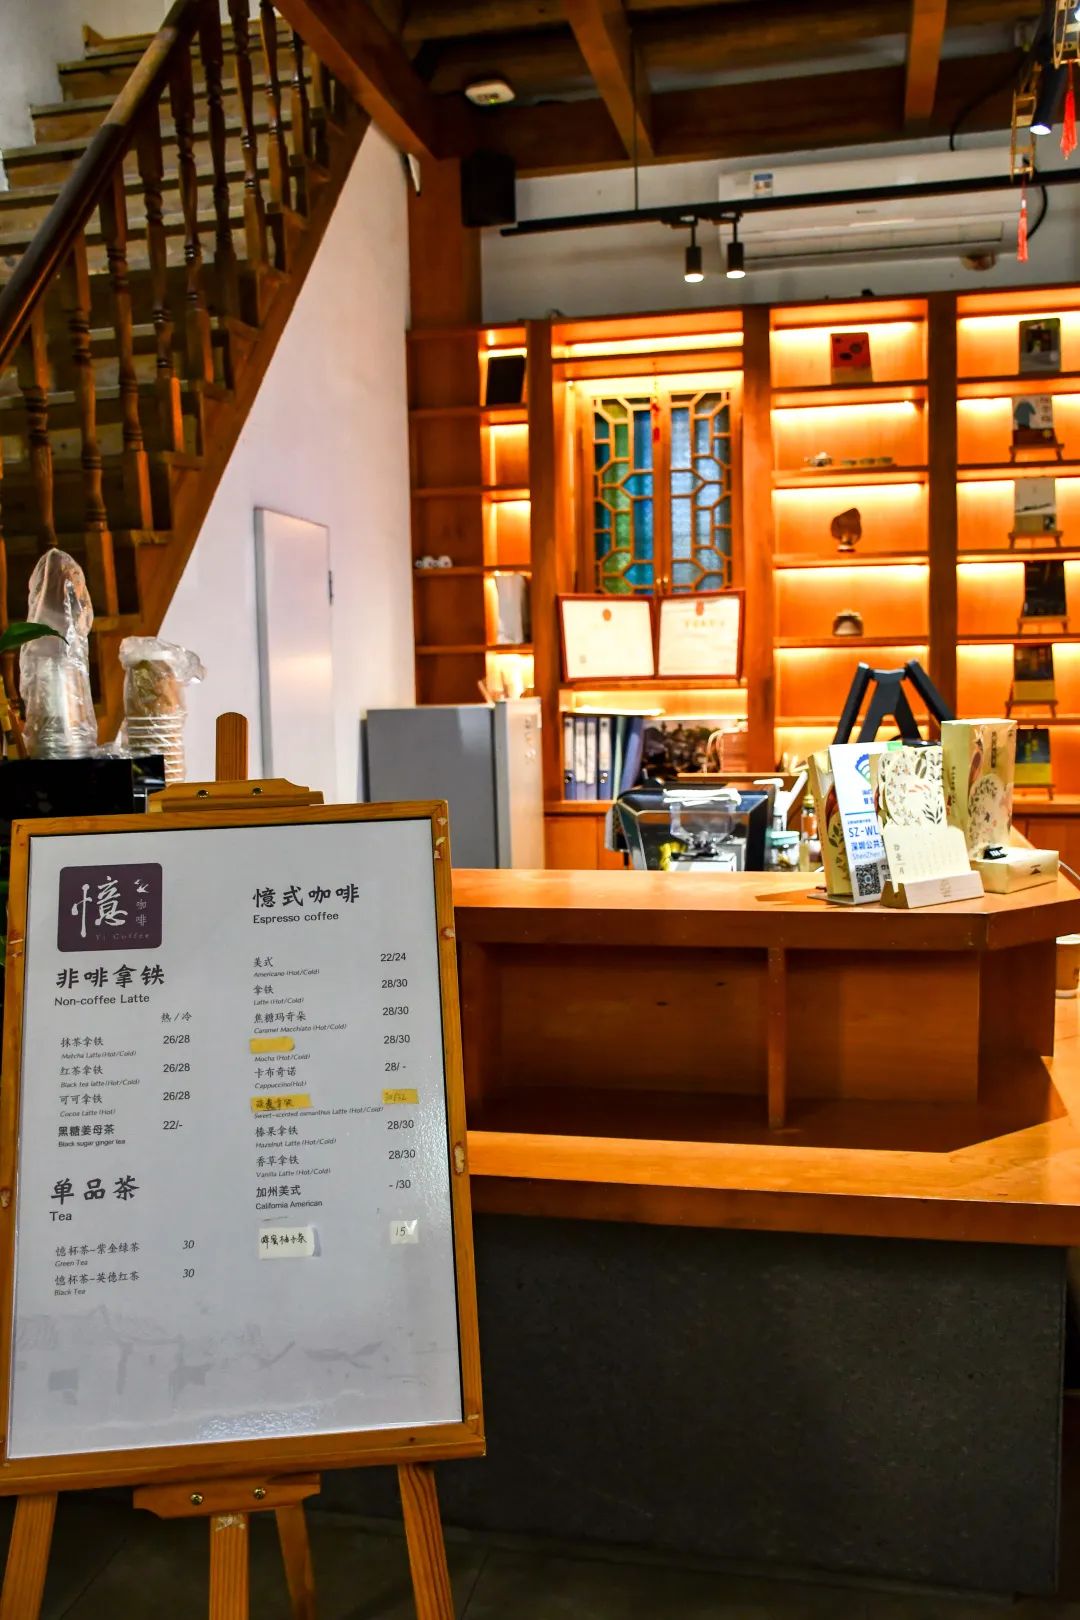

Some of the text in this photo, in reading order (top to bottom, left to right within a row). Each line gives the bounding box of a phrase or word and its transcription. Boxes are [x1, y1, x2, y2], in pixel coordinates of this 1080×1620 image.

[252, 884, 360, 908] 憶式咖啡
[71, 876, 129, 938] 憶
[136, 899, 147, 926] 咖啡
[253, 912, 339, 925] Espresso coffee
[253, 956, 274, 968] 美式
[380, 952, 406, 962] 22/24
[56, 964, 165, 989] 非啡拿铁
[253, 970, 285, 978] Americano
[381, 978, 408, 988] 28/30
[253, 984, 274, 996] 拿铁
[54, 994, 150, 1006] Non-coffee Latte
[382, 1006, 409, 1016] 28/30
[254, 1011, 306, 1024] 焦糖玛奇朵
[280, 1025, 312, 1033] Macchiato
[60, 1036, 104, 1048] 抹茶拿铁
[163, 1035, 190, 1044] 26/28
[383, 1034, 410, 1044] 28/30
[60, 1064, 104, 1076] 红茶拿铁
[163, 1063, 191, 1072] 26/28
[254, 1066, 297, 1078] 卡布奇诺
[60, 1094, 103, 1106] 可可拿铁
[163, 1091, 191, 1100] 26/28
[60, 1110, 80, 1118] Cocoa
[162, 1120, 183, 1130] 22/-
[387, 1120, 414, 1130] 28/30
[58, 1124, 115, 1137] 黑糖姜母茶
[255, 1126, 298, 1138] 榛果拿铁
[58, 1140, 75, 1148] Black
[76, 1140, 94, 1148] sugar
[96, 1139, 114, 1148] ginger
[388, 1150, 416, 1160] 28/30
[256, 1154, 300, 1167] 香草拿铁
[256, 1170, 277, 1178] Vanilla
[50, 1174, 140, 1206] 单品茶
[256, 1184, 302, 1198] 加州美式
[256, 1200, 322, 1210] California American
[49, 1211, 72, 1222] Tea
[395, 1226, 406, 1237] 15
[182, 1240, 195, 1250] 30
[54, 1260, 74, 1268] Green
[182, 1268, 195, 1278] 30
[74, 1288, 86, 1296] Tea
